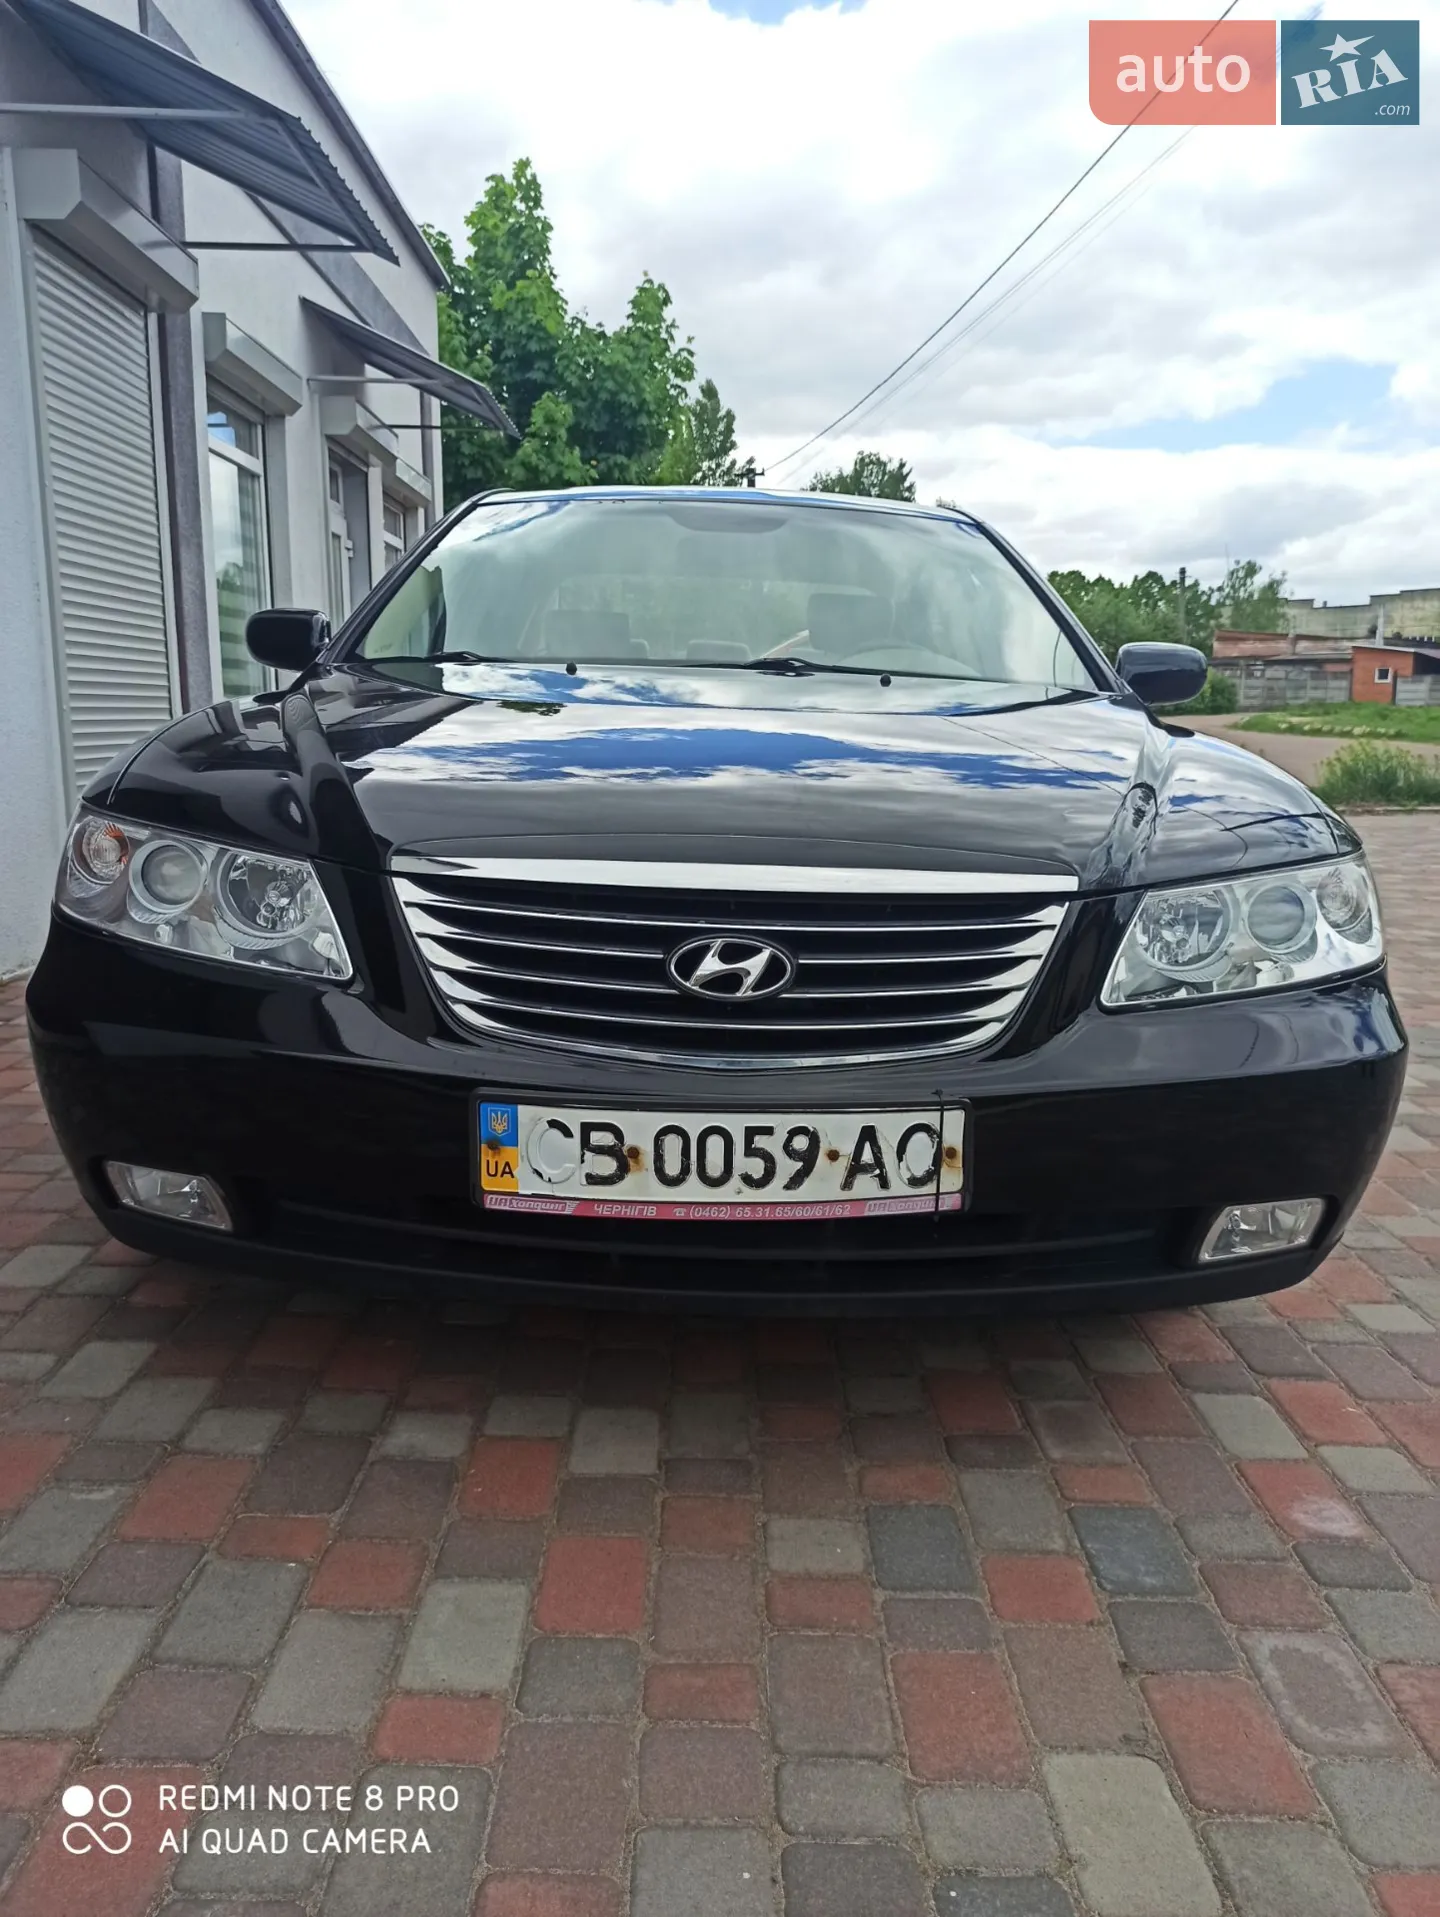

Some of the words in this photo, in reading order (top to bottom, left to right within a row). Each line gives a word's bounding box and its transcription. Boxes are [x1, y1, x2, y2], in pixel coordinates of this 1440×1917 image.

[653, 1122, 821, 1191] 0059
[486, 1158, 515, 1178] UA
[689, 1205, 731, 1219] (0462)
